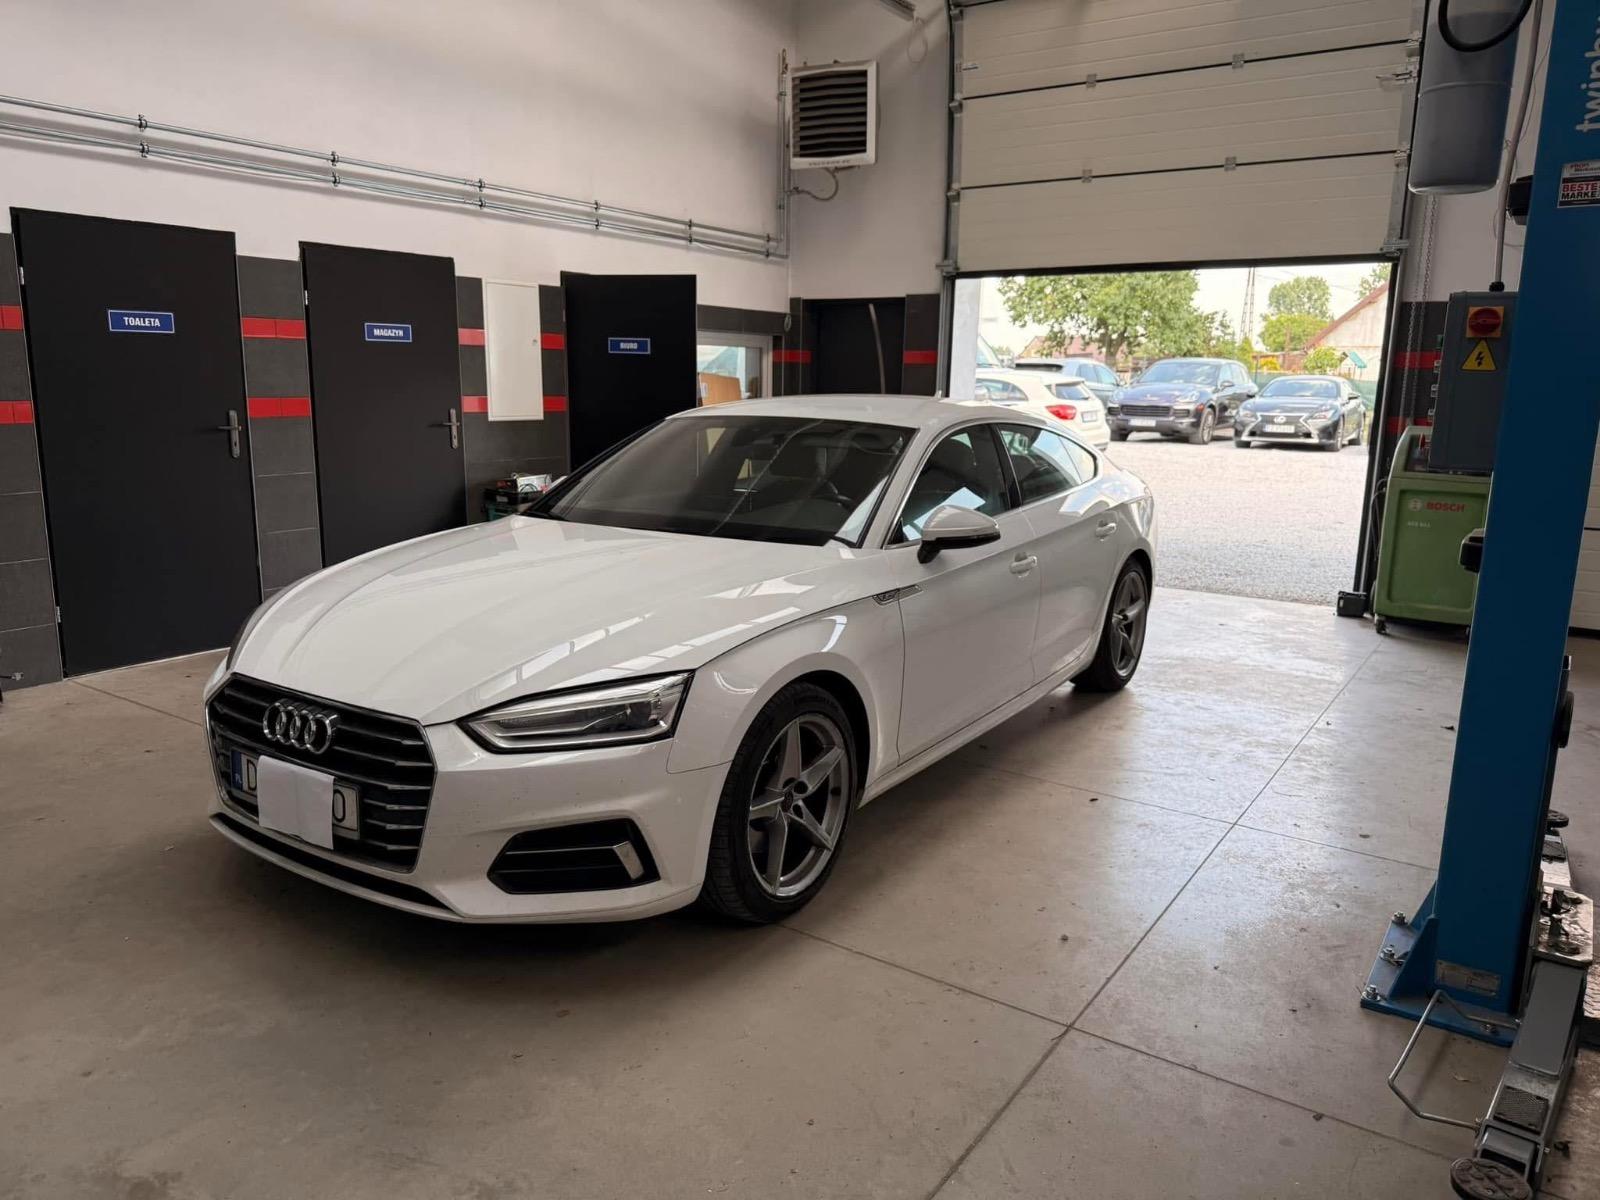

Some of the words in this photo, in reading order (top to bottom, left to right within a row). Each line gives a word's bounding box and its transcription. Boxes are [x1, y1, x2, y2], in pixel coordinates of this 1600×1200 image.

[1562, 182, 1598, 192] BESTE
[122, 316, 161, 327] TOALETA
[373, 328, 404, 337] MAGAZYN
[1425, 501, 1465, 512] BOSCH
